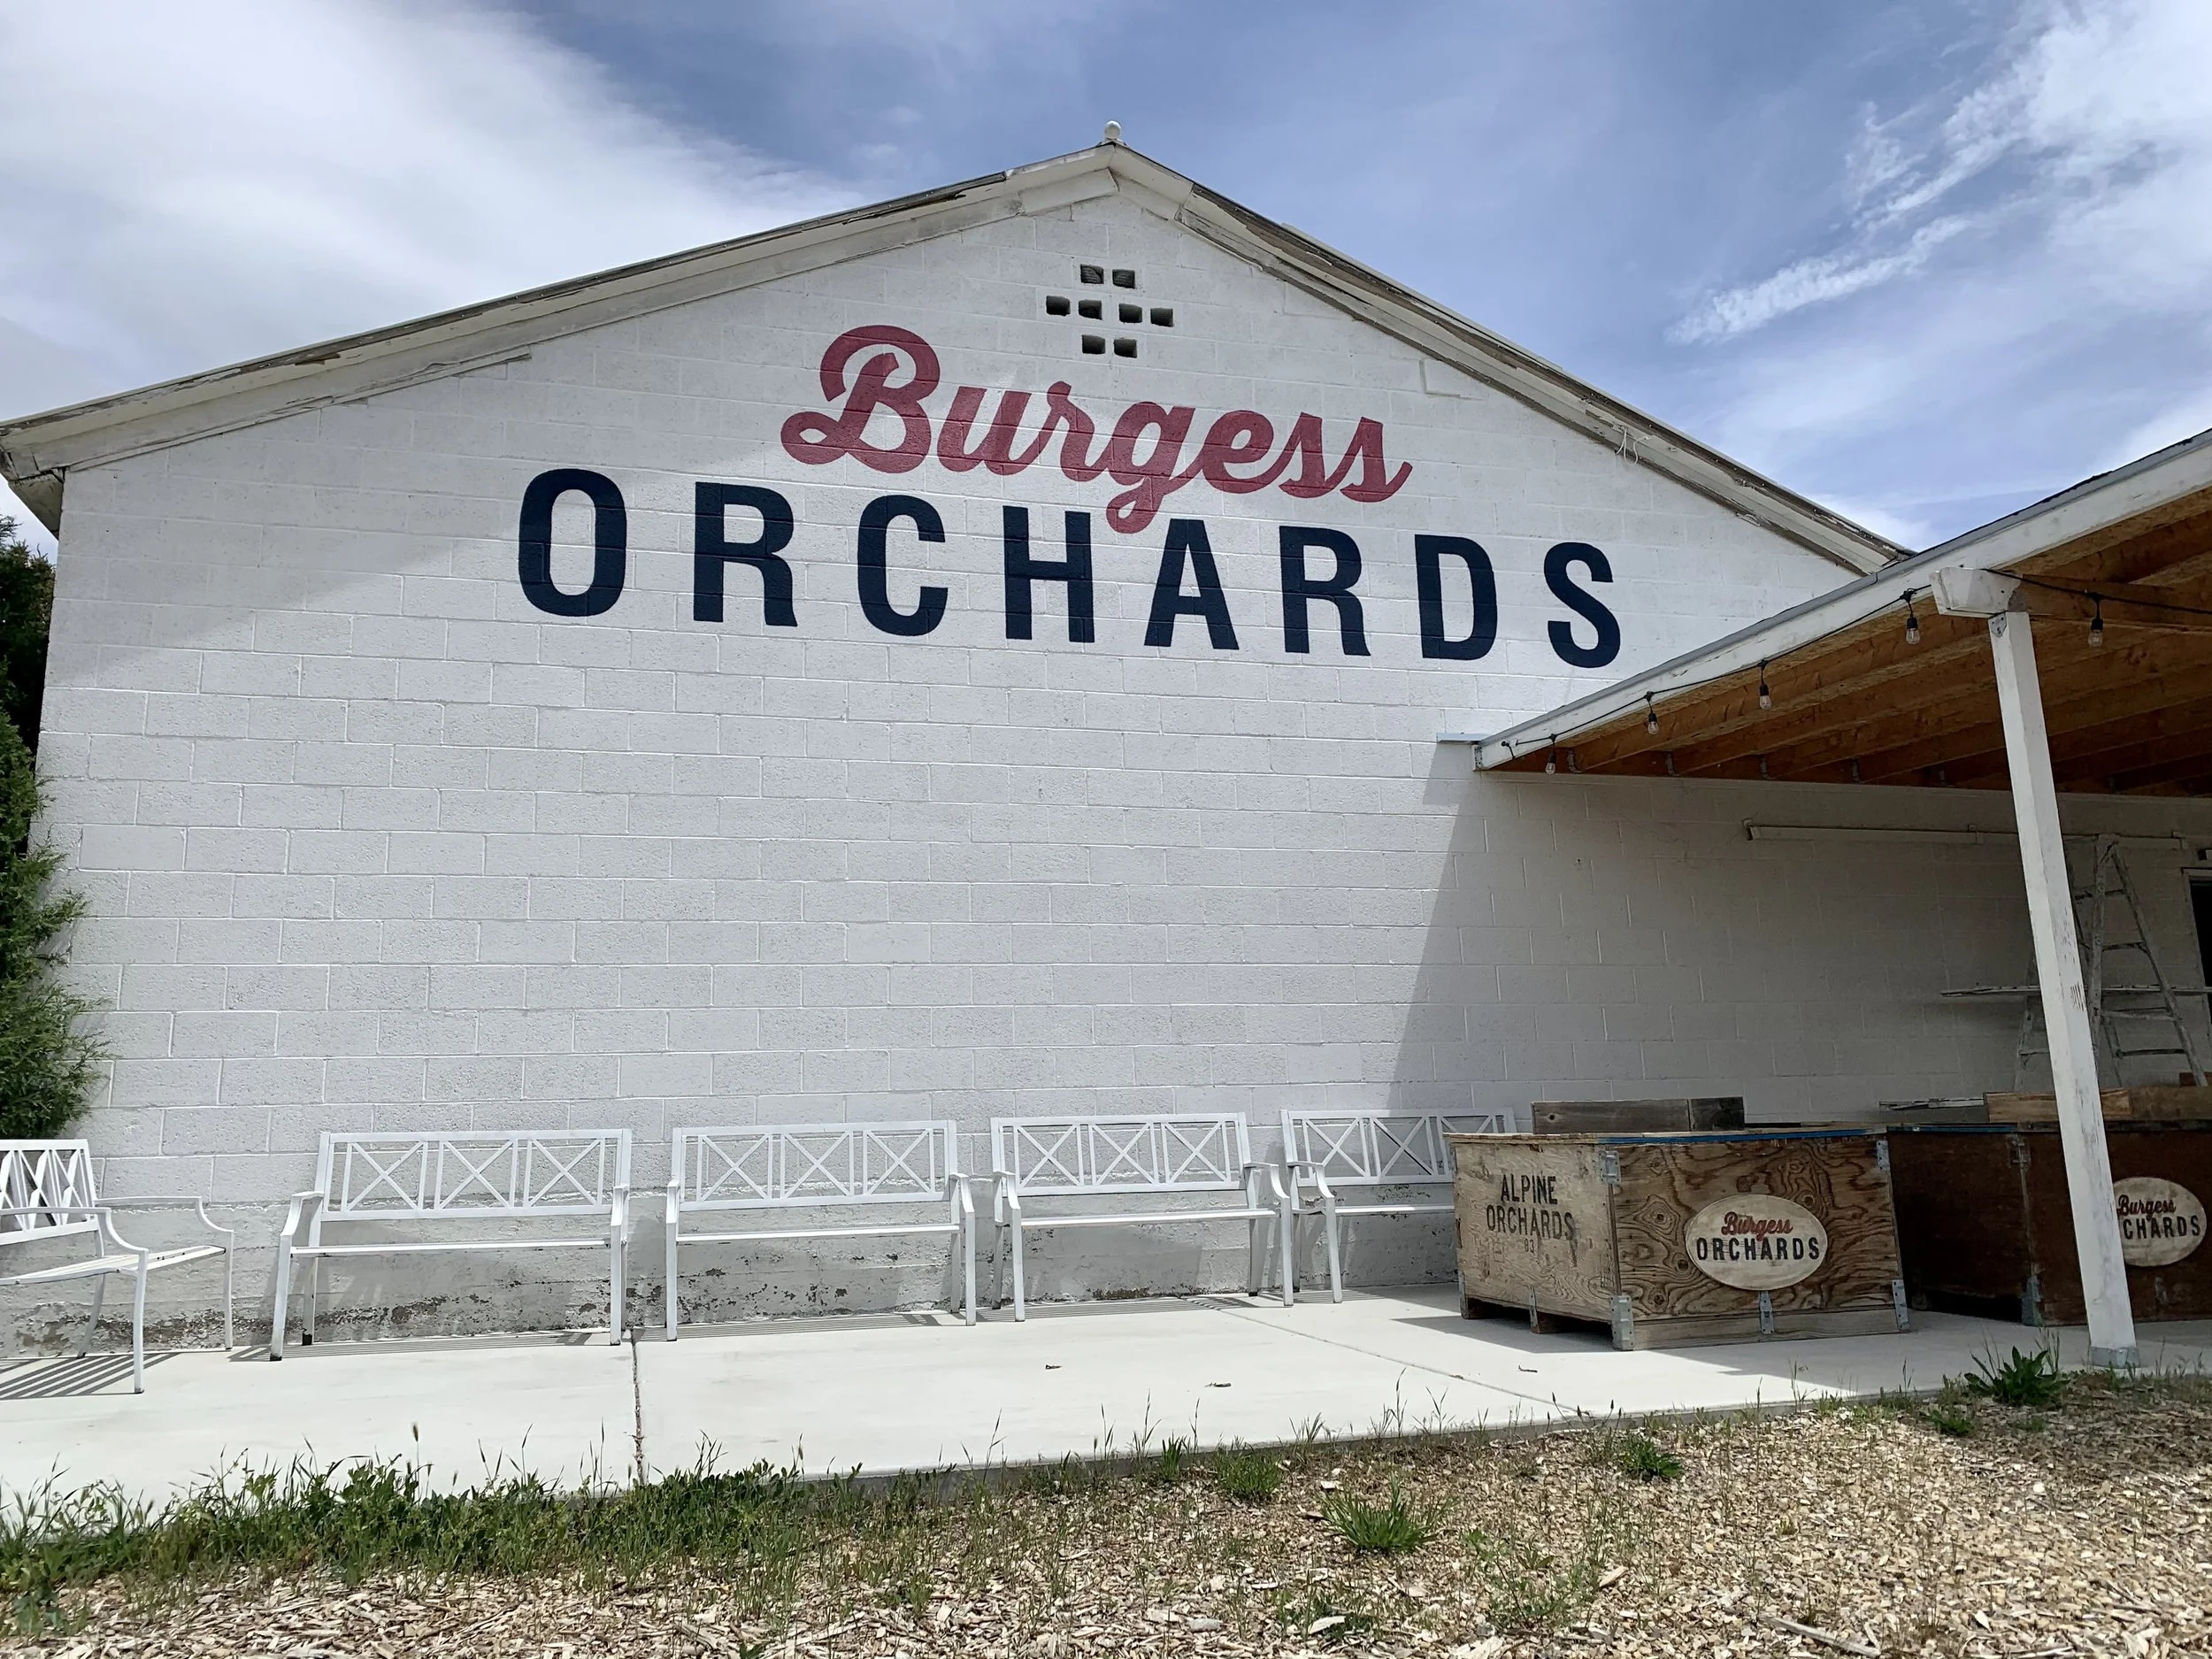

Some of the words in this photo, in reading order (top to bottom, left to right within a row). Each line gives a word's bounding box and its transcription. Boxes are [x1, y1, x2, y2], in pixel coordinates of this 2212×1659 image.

[782, 325, 1413, 534] Burgess
[518, 469, 1620, 668] ORCHARDS
[1501, 1173, 1558, 1204] ALPINE
[1486, 1204, 1576, 1240] ORCHARDS
[2116, 1194, 2177, 1221] Burgess
[1721, 1211, 1793, 1241] Burgess
[2123, 1215, 2201, 1240] CHARDS
[1696, 1237, 1820, 1261] ORCHARDS
